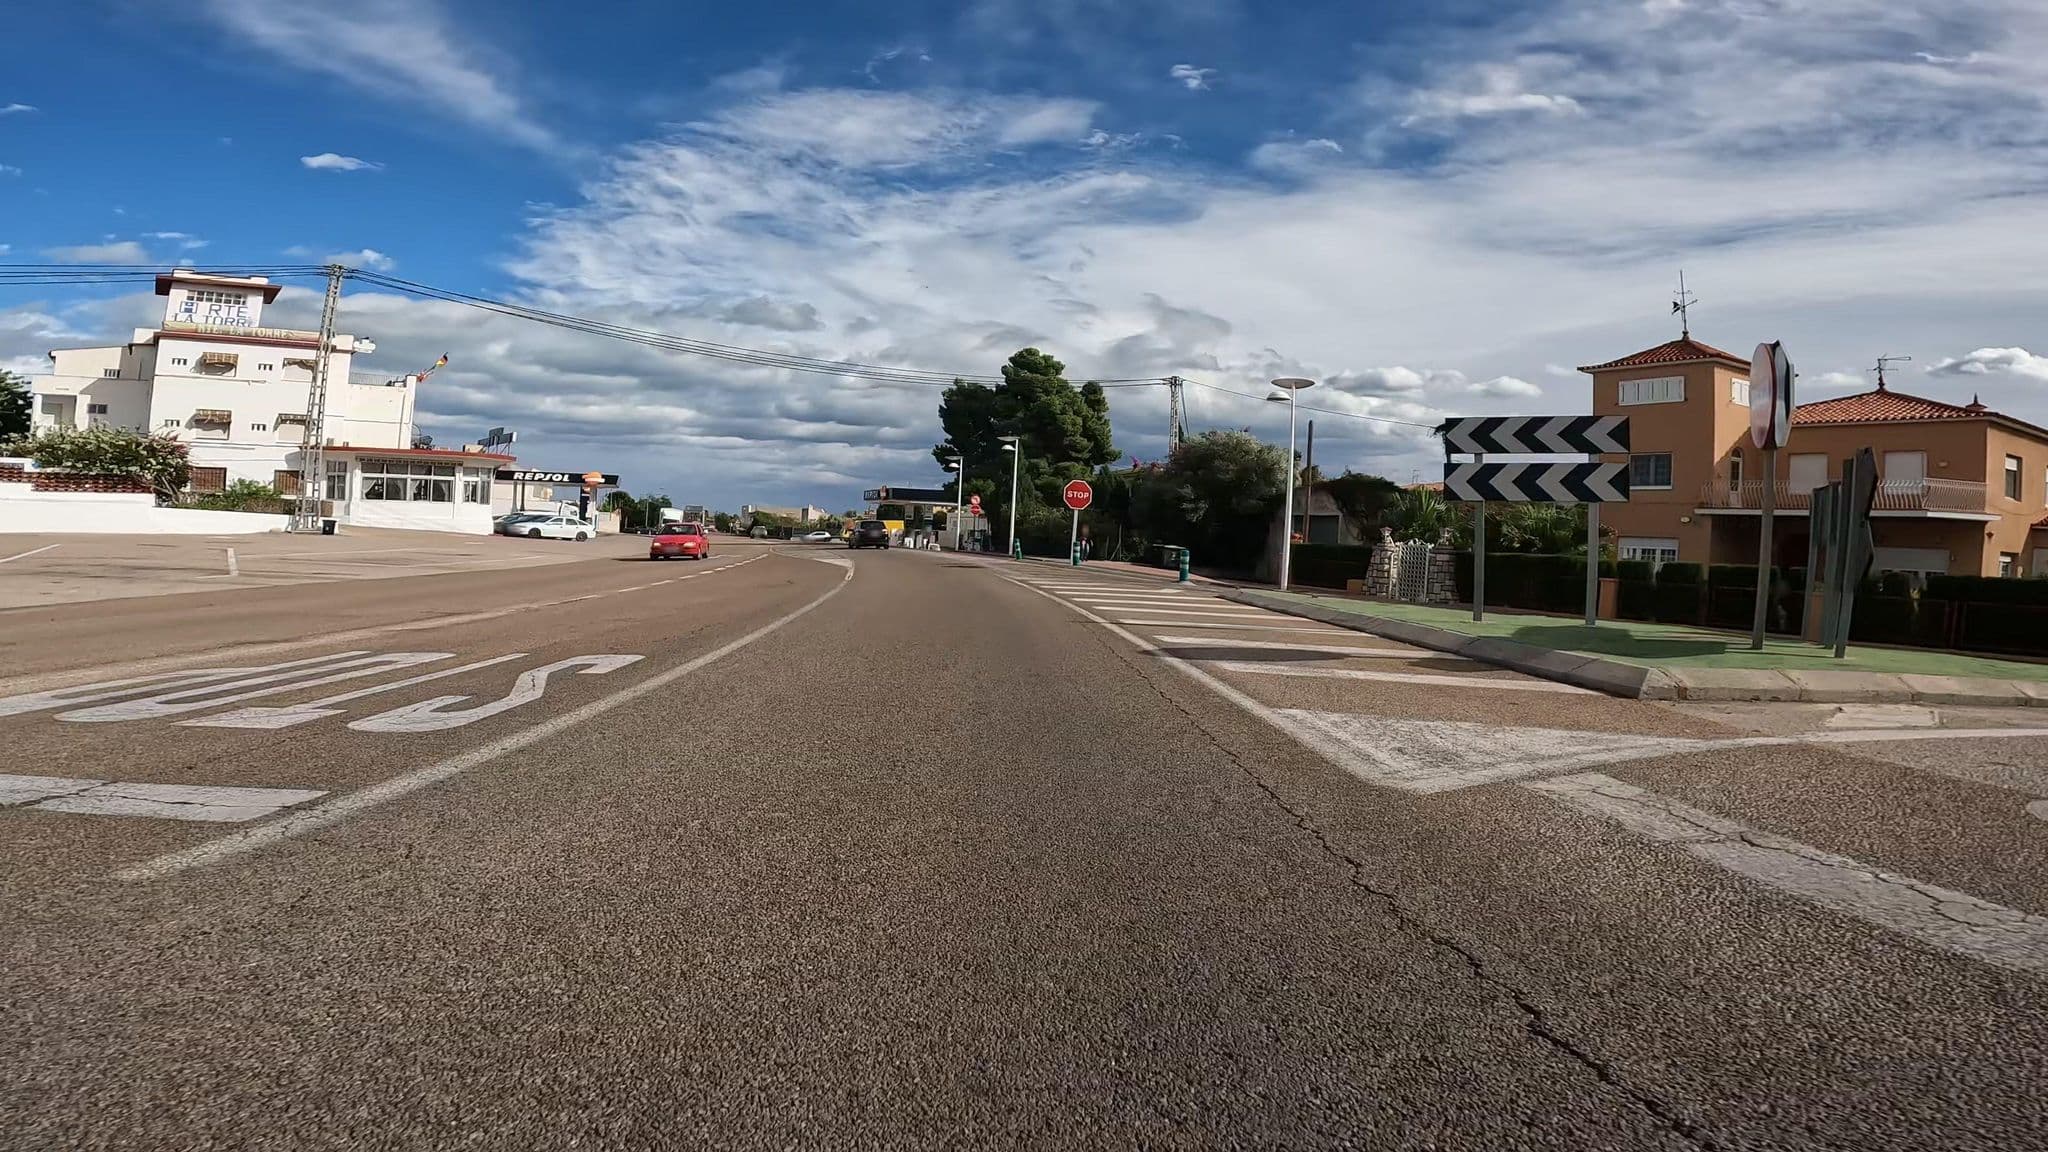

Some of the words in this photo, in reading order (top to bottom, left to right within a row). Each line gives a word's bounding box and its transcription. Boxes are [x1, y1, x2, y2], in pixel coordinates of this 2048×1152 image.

[173, 313, 194, 323] LA
[203, 314, 253, 328] TORR
[513, 472, 570, 482] REPSOL
[1067, 490, 1089, 499] STOP
